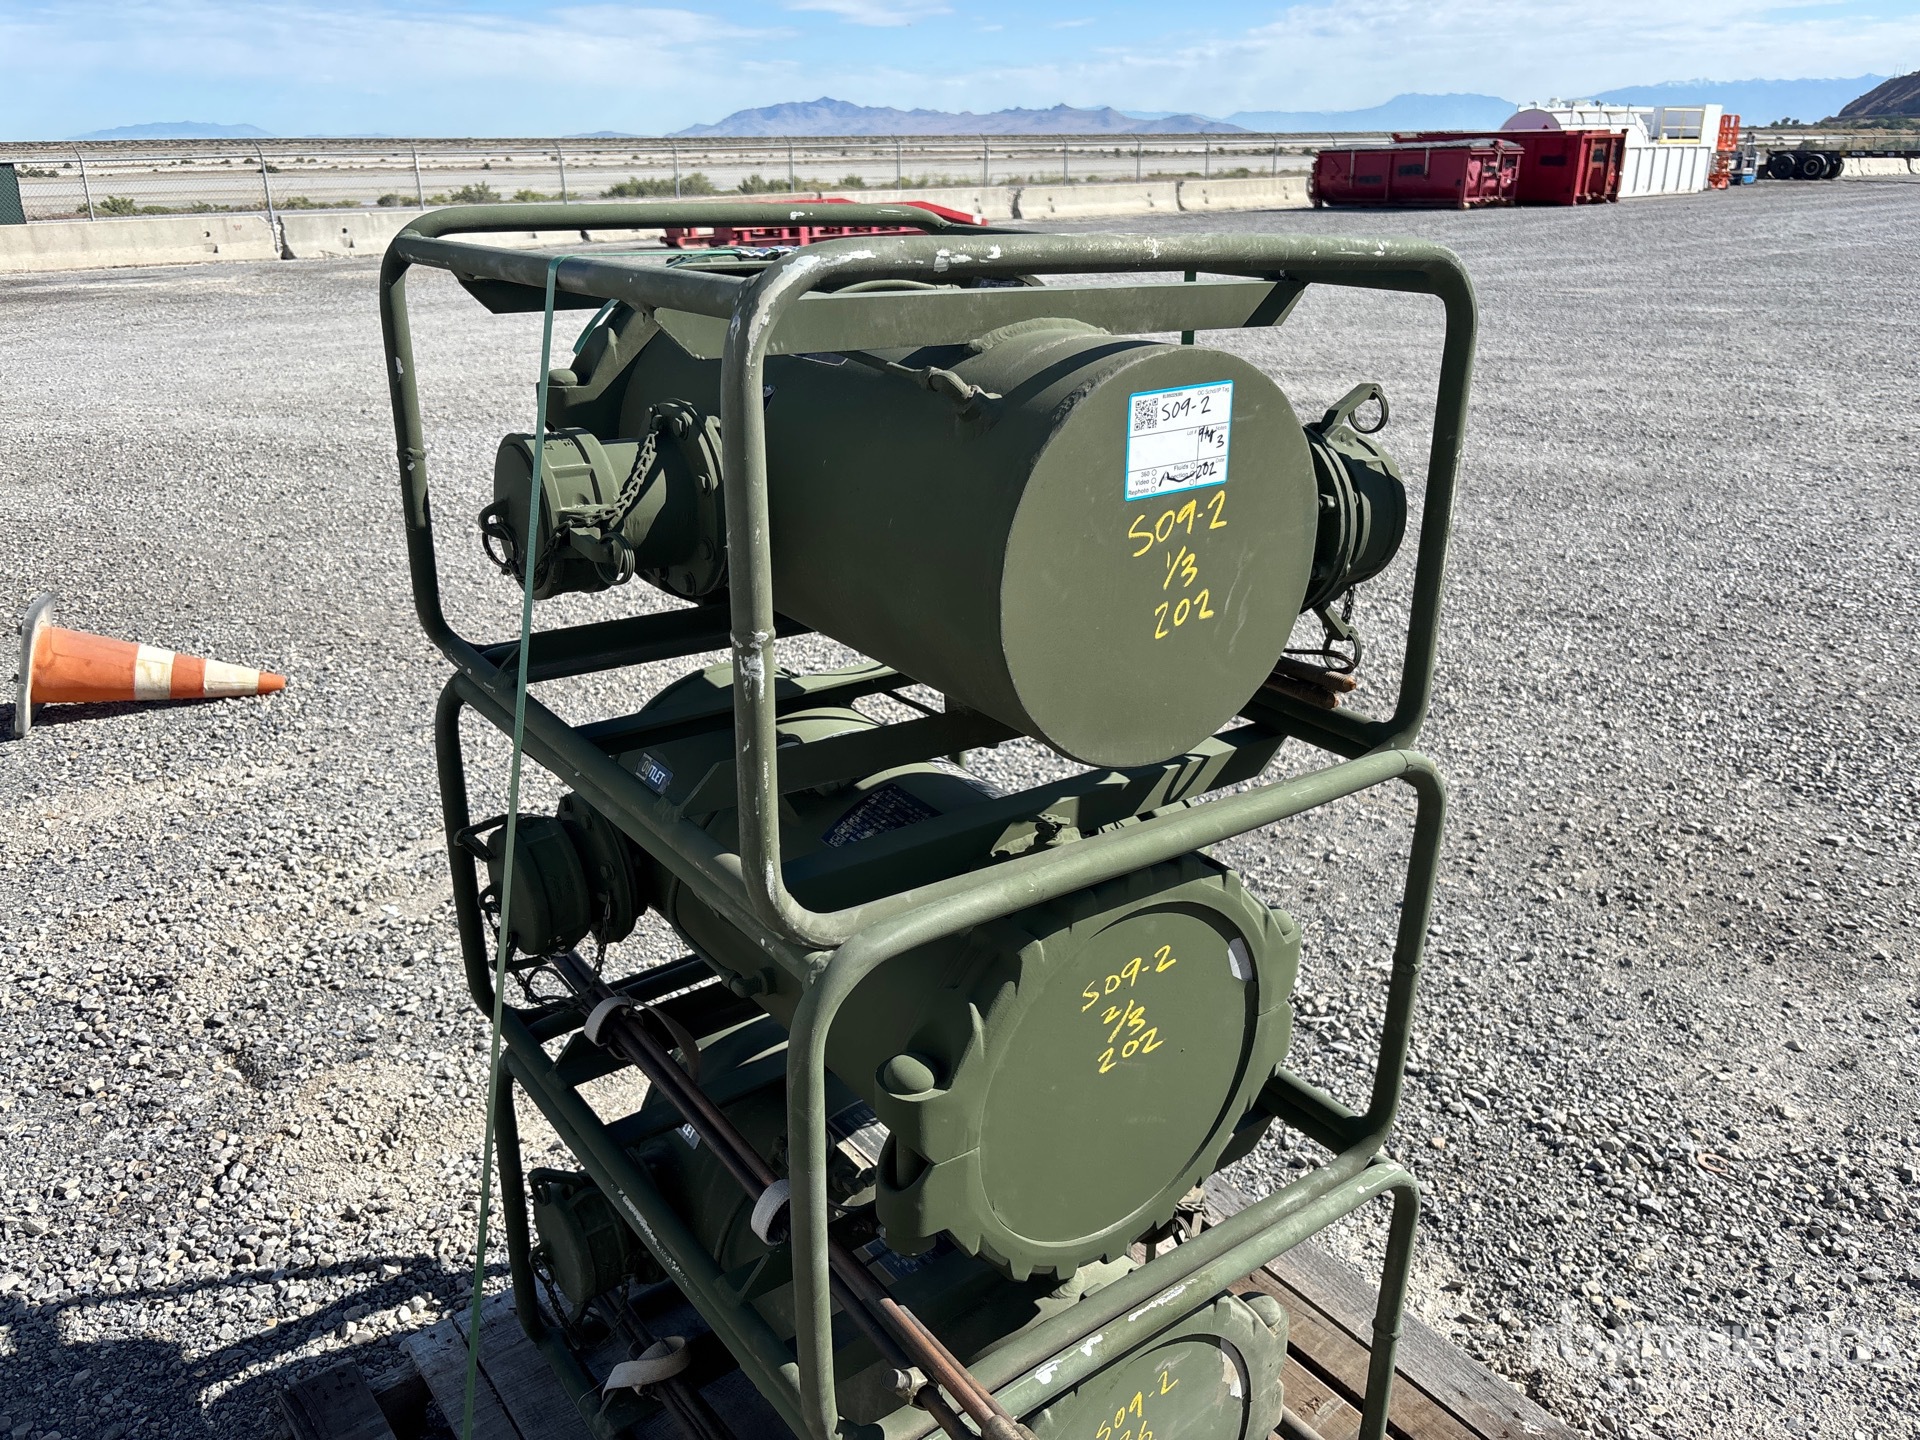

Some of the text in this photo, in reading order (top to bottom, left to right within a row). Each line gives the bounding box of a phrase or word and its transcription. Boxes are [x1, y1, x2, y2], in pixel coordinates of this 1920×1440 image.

[1161, 395, 1212, 421] S09-2
[1173, 463, 1189, 471] Fluids
[1195, 461, 1217, 479] 202
[1128, 487, 1150, 496] Rephoto
[1128, 490, 1228, 558] S09-2
[1163, 545, 1198, 590] 1/3
[1154, 588, 1215, 640] 202
[641, 760, 666, 785] OUTLET
[1081, 944, 1177, 1013] S09-2
[1101, 999, 1146, 1044] 2/3
[1097, 1027, 1168, 1074] 202
[682, 1123, 695, 1139] LET
